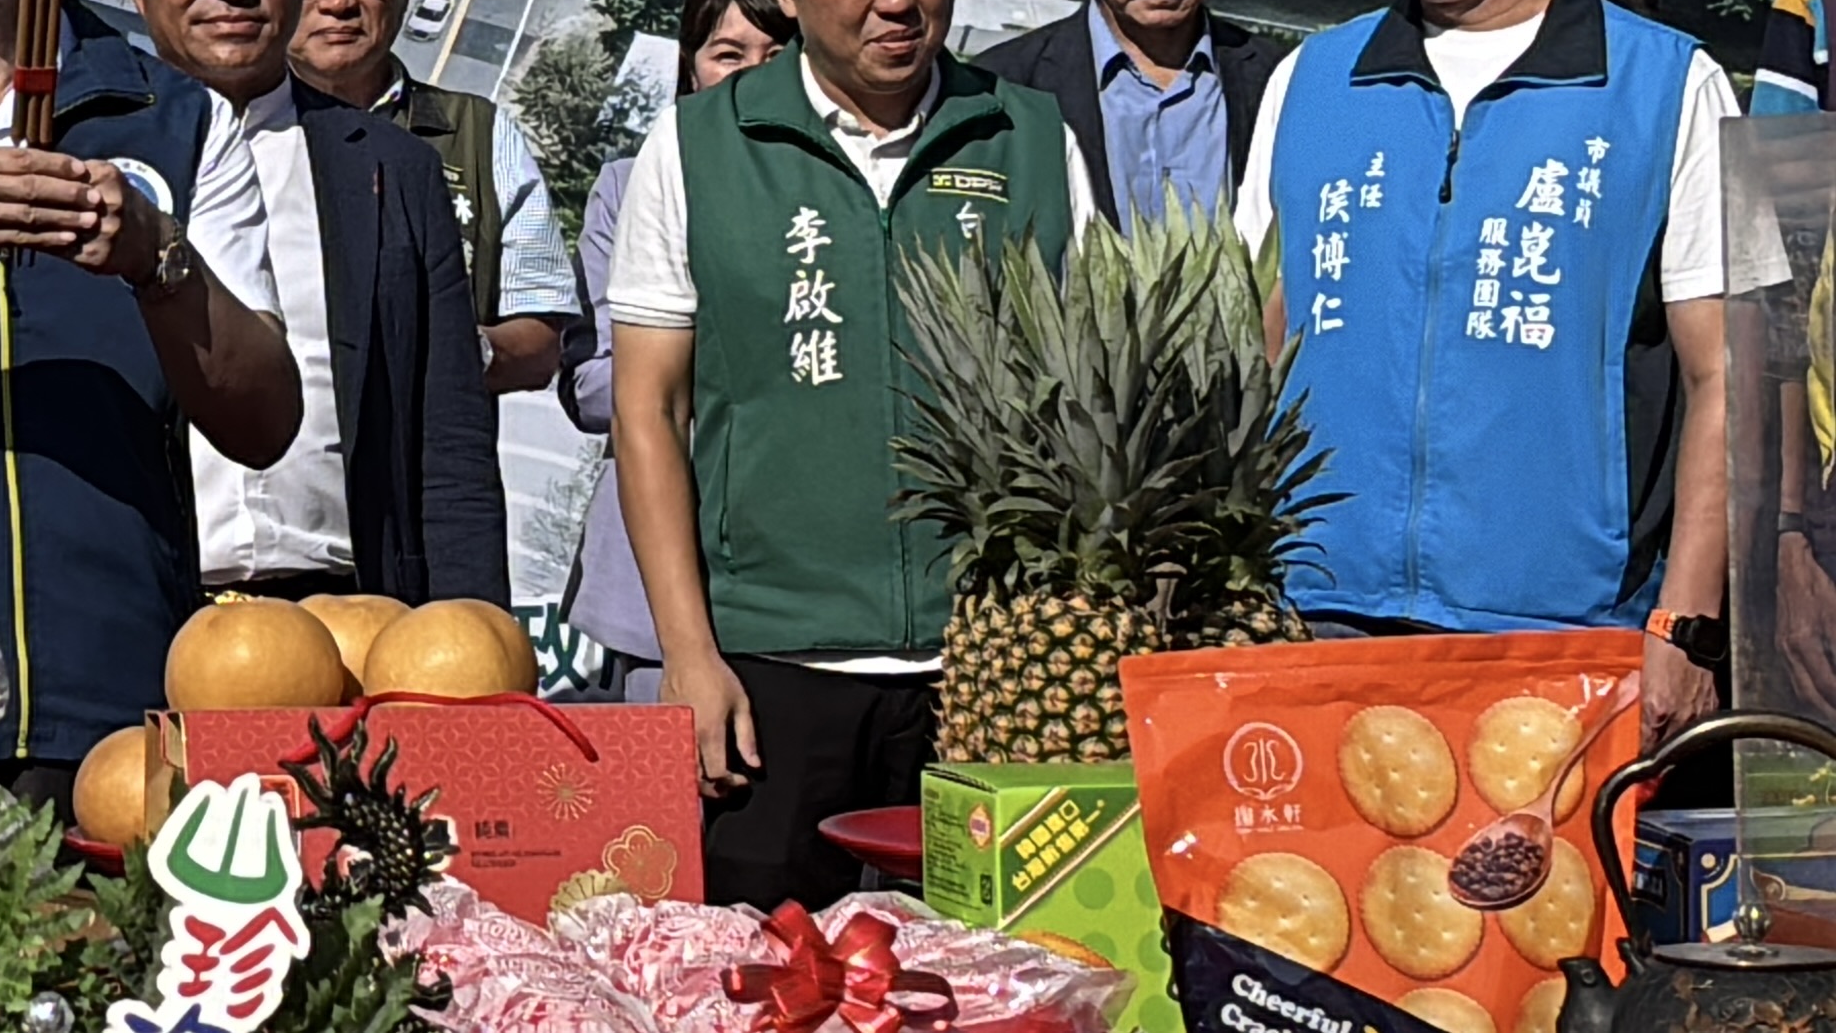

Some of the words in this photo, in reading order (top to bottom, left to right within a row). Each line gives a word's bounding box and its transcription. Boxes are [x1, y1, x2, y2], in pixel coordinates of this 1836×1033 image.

[1359, 151, 1386, 209] 主任
[1573, 136, 1611, 229] 市議員
[783, 205, 846, 387] 李啟維
[1311, 178, 1353, 336] 侯博仁
[1465, 217, 1510, 341] 服務團隊
[1498, 157, 1570, 350] 盧崑福
[126, 786, 299, 1033] 山珍
[1230, 972, 1354, 1033] Cheerful
